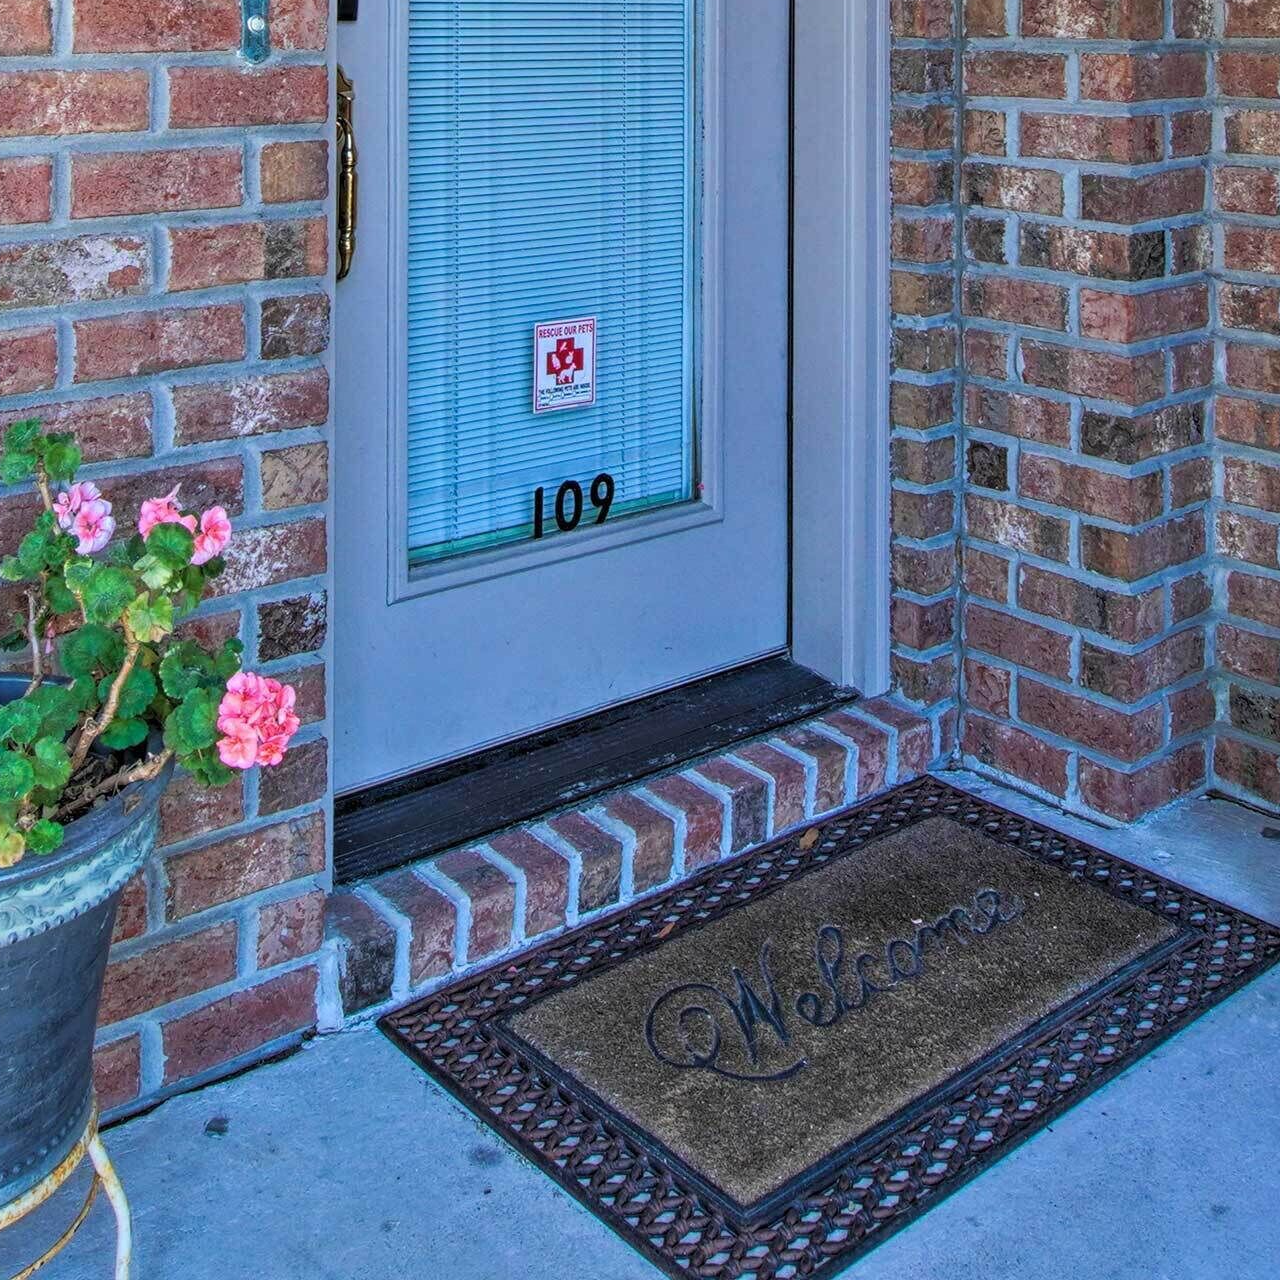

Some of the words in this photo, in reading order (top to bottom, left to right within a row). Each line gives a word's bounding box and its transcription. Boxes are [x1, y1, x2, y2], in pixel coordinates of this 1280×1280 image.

[538, 327, 562, 338] RESCUE
[563, 325, 577, 336] OUR
[578, 323, 593, 334] PETS
[533, 473, 615, 539] 109
[644, 887, 1022, 1082] Welcome
